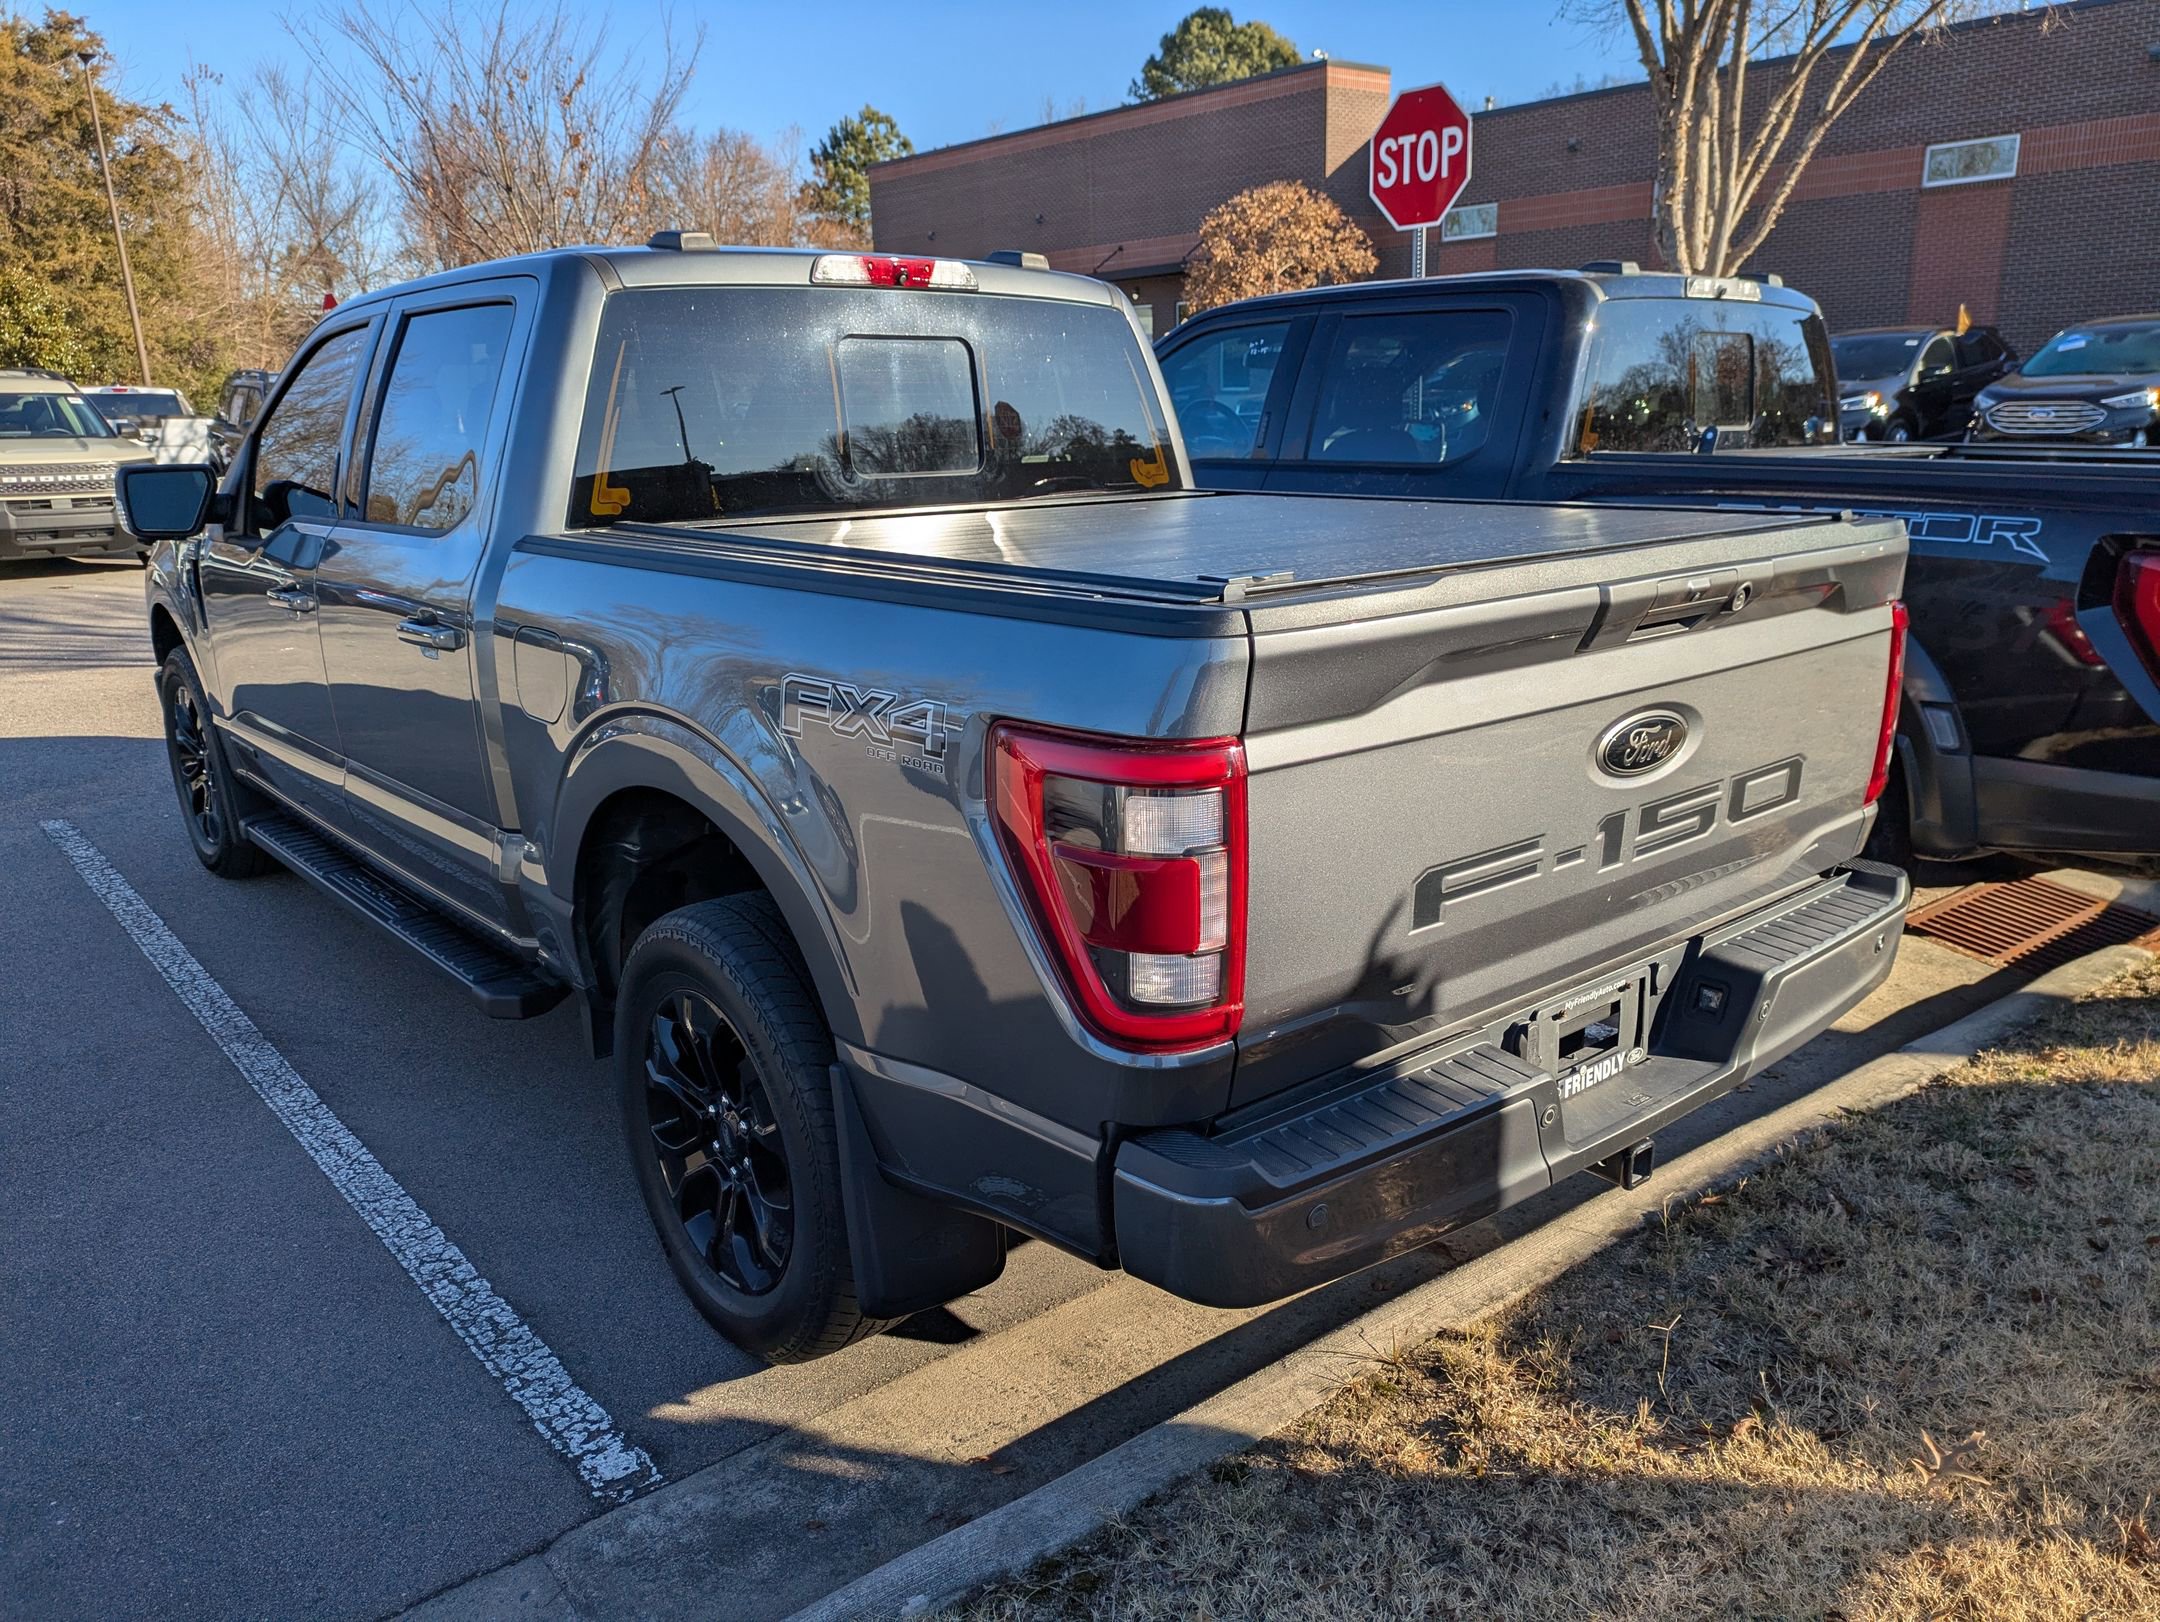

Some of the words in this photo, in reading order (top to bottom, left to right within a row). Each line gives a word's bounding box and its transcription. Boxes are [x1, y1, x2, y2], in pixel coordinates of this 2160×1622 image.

[1378, 126, 1463, 188] STOP
[2, 474, 106, 483] BRONCO
[781, 673, 947, 760] FX4
[866, 747, 897, 761] OFF
[901, 755, 945, 773] ROAD
[1624, 725, 1672, 766] Ford
[1409, 754, 1806, 936] F-150
